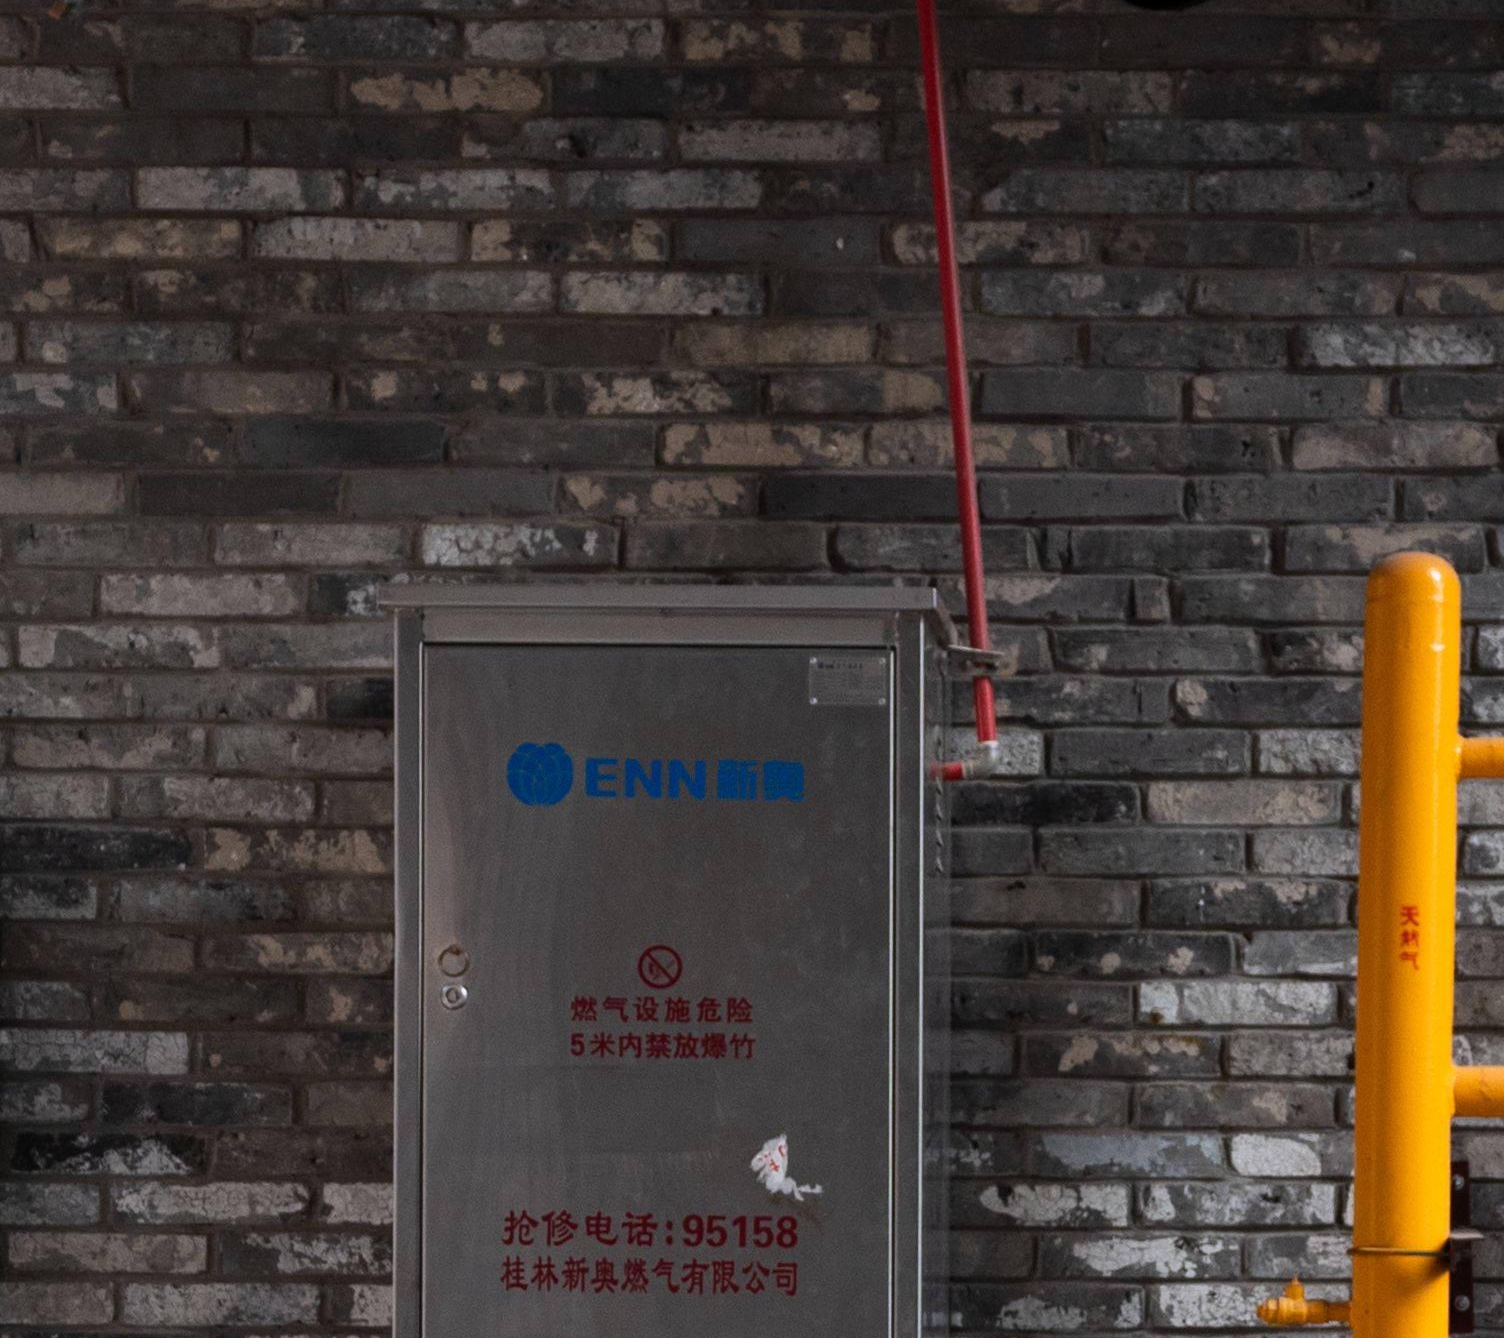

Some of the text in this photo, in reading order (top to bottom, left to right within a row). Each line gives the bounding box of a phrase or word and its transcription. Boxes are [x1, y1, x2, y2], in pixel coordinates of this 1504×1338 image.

[585, 758, 707, 799] ENN
[1399, 906, 1419, 970] 天然气
[570, 996, 753, 1023] 燃气设施危险
[570, 1032, 756, 1059] 5米内禁放爆竹
[500, 1256, 798, 1296] 桂林新奥燃气有限公司
